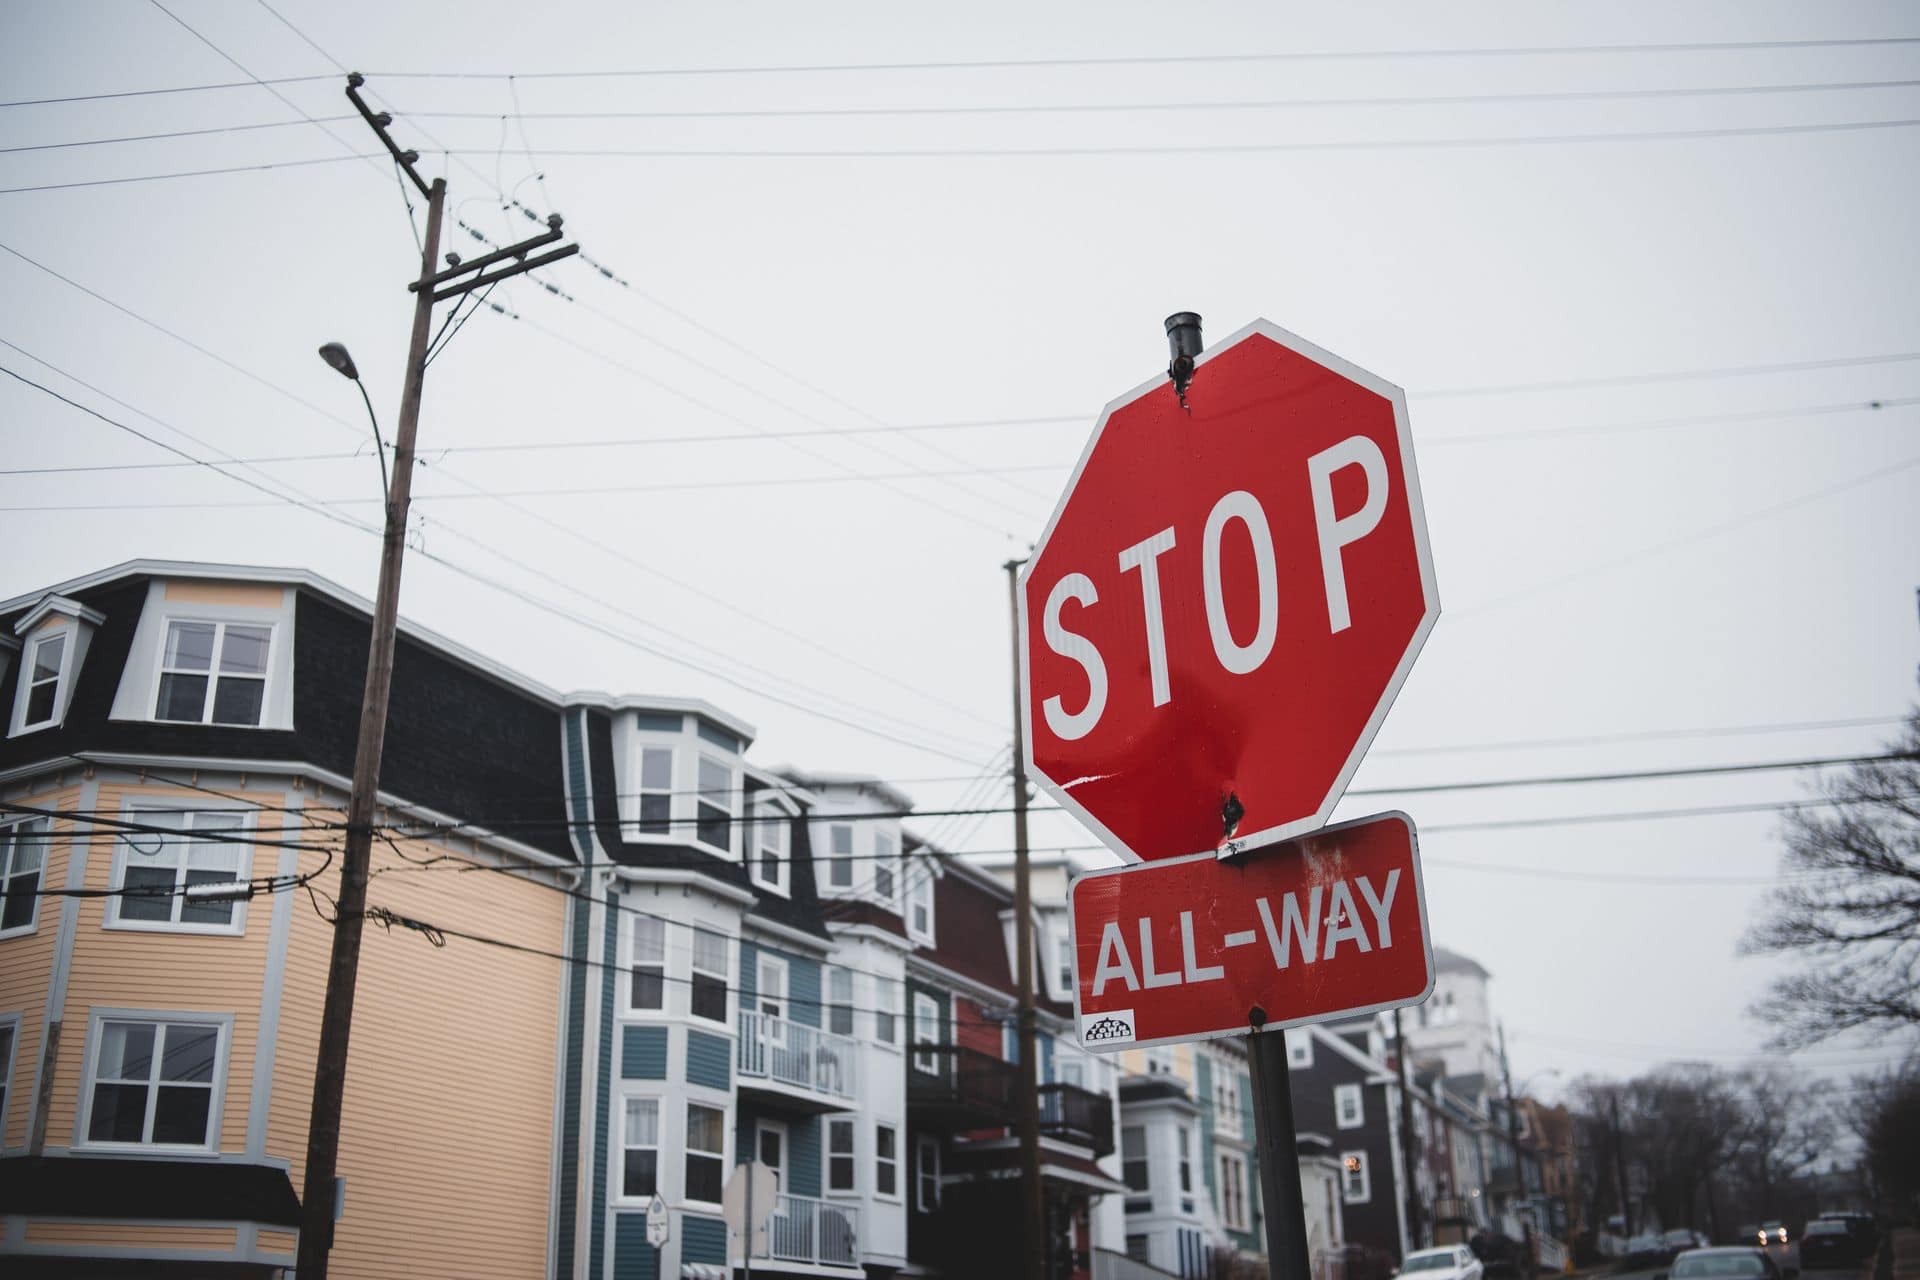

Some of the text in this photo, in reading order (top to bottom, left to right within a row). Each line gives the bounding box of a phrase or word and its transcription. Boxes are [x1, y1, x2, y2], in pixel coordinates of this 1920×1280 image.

[1042, 435, 1389, 740] STOP
[1091, 868, 1401, 997] ALL-WAY
[1090, 1025, 1127, 1035] TOWN
